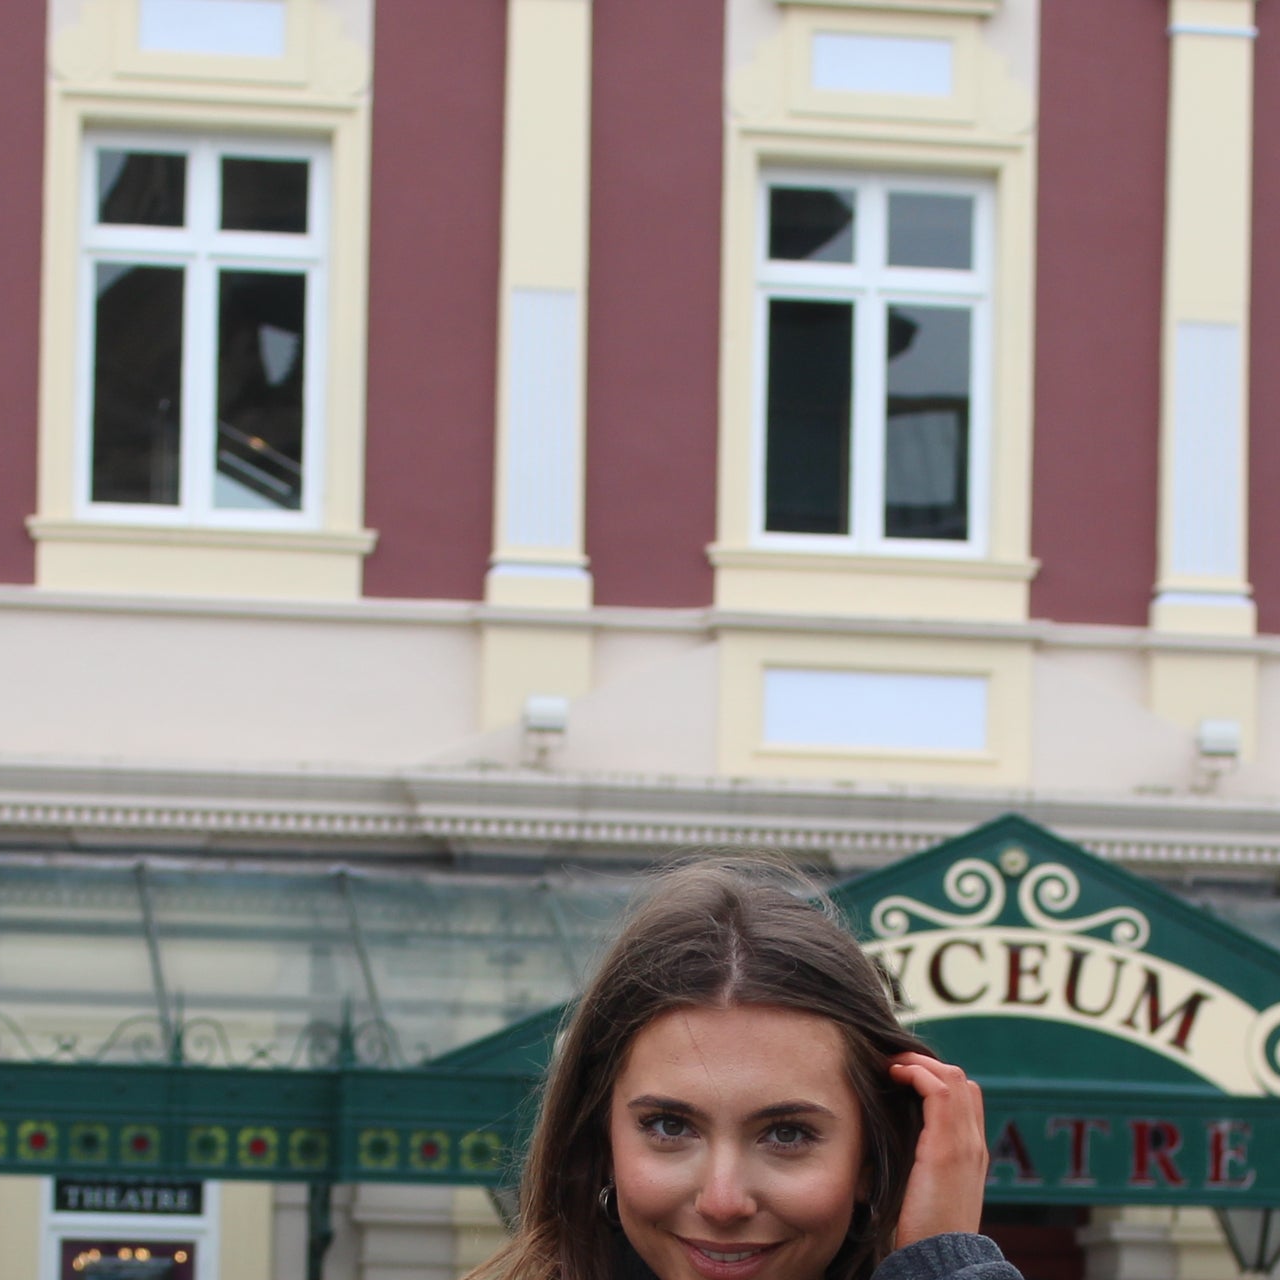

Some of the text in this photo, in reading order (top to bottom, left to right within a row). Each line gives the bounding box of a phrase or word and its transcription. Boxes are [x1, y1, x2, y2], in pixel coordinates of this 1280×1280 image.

[871, 936, 1213, 1055] YCEUM
[985, 1115, 1258, 1191] ATRE
[64, 1186, 192, 1210] THEATRE
